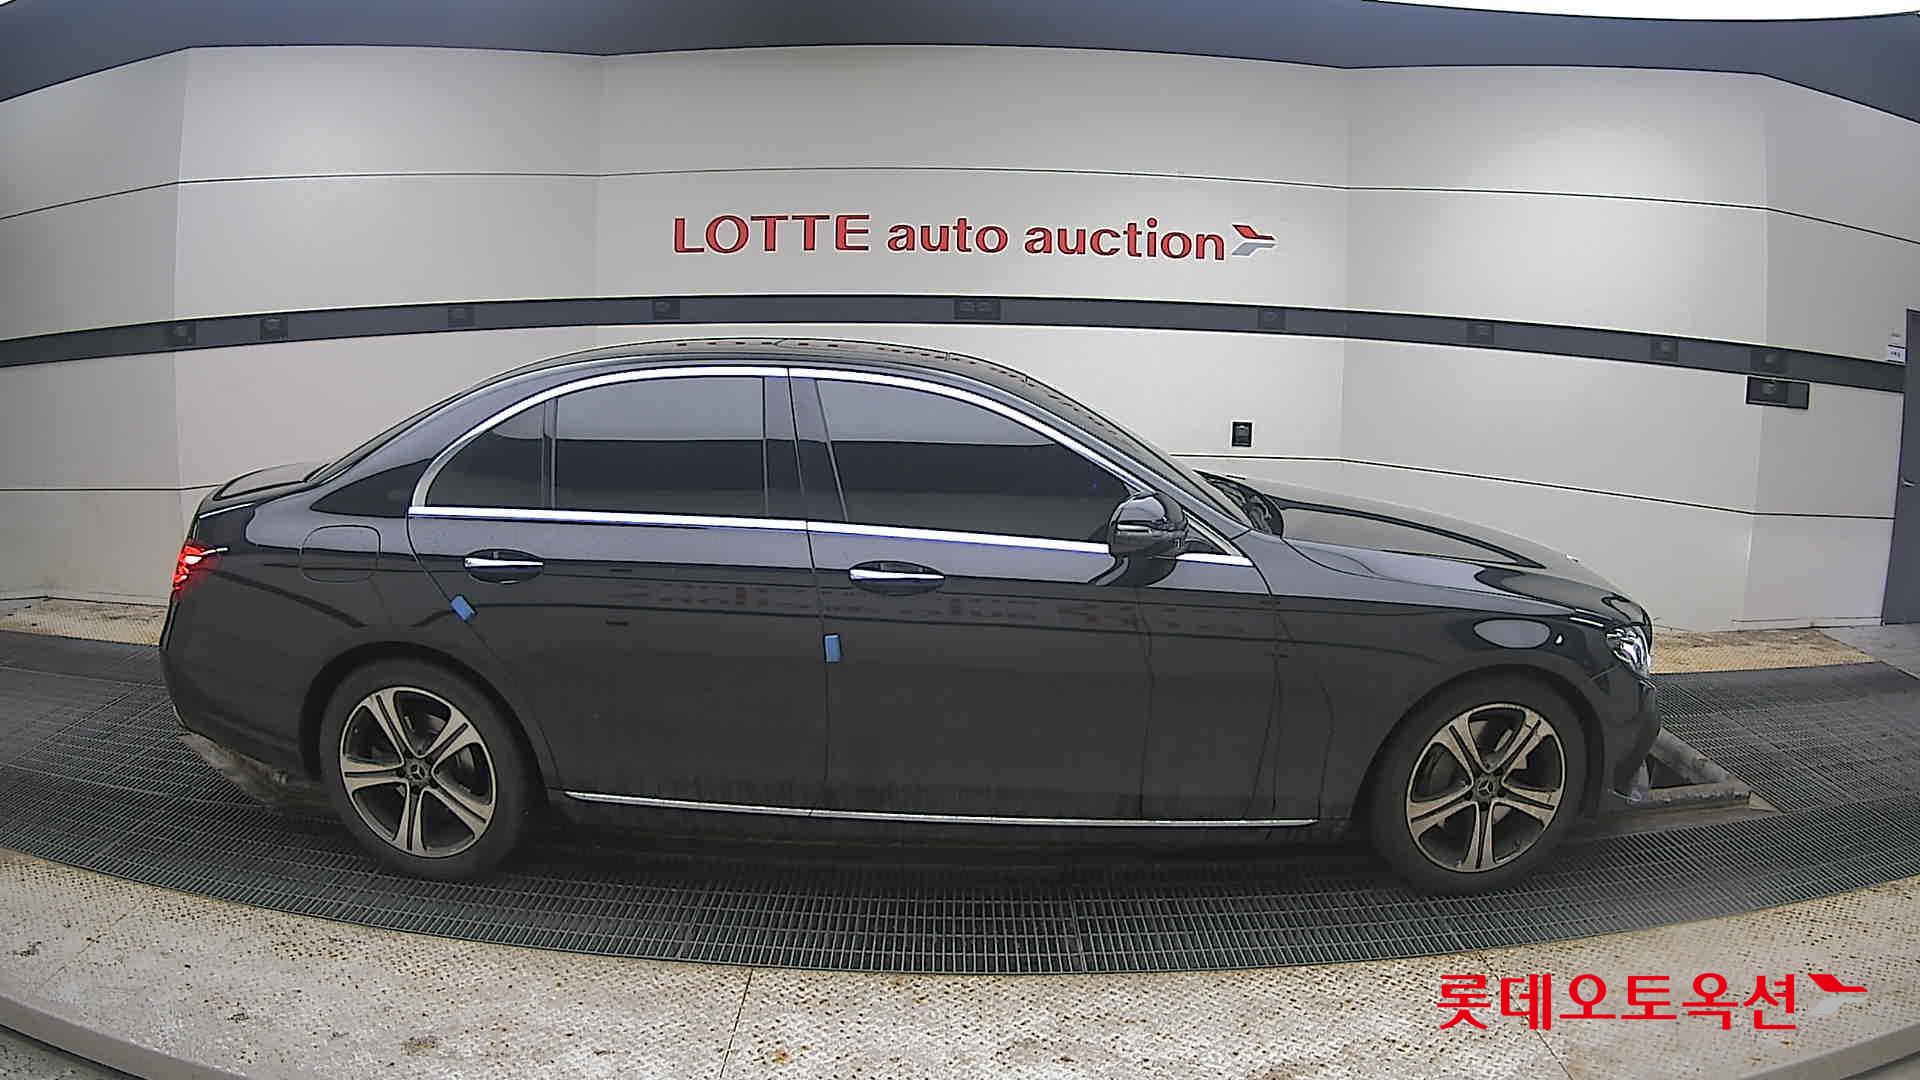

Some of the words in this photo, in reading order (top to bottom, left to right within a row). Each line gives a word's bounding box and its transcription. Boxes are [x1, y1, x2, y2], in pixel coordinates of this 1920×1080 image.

[674, 214, 869, 254] LOTTE
[887, 218, 1008, 253] auto
[1024, 217, 1225, 260] auction
